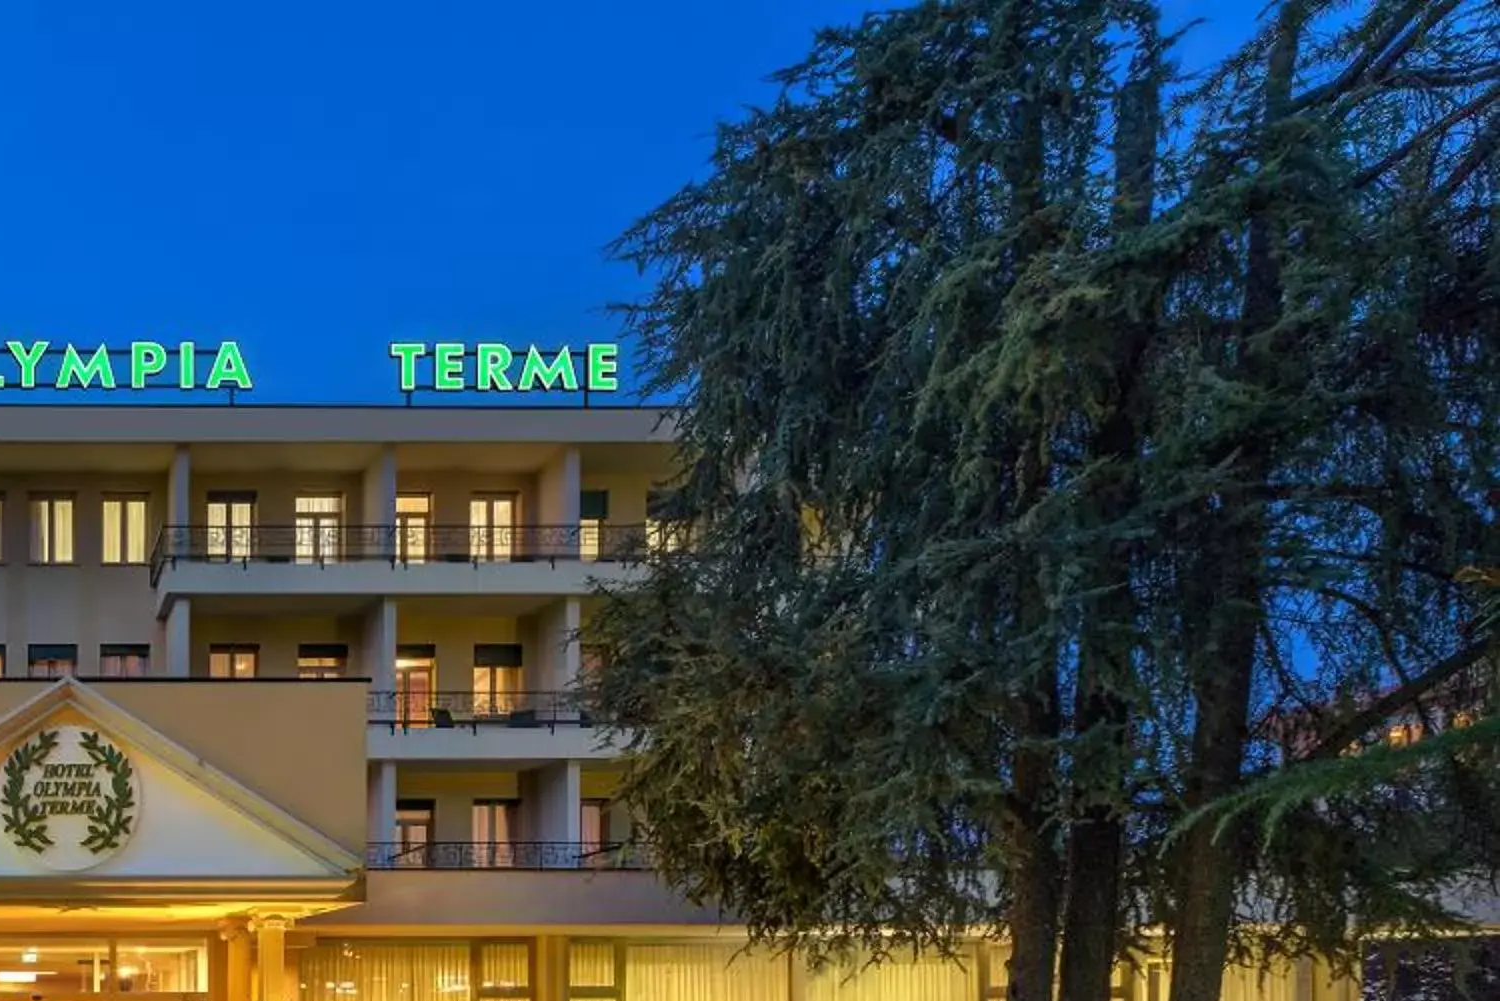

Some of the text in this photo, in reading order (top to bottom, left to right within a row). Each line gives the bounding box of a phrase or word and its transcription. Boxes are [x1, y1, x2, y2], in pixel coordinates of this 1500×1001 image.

[390, 342, 620, 391] TERME
[44, 763, 95, 778] HOTEL
[33, 781, 102, 797] OLYMPIA
[39, 800, 95, 815] TERME
